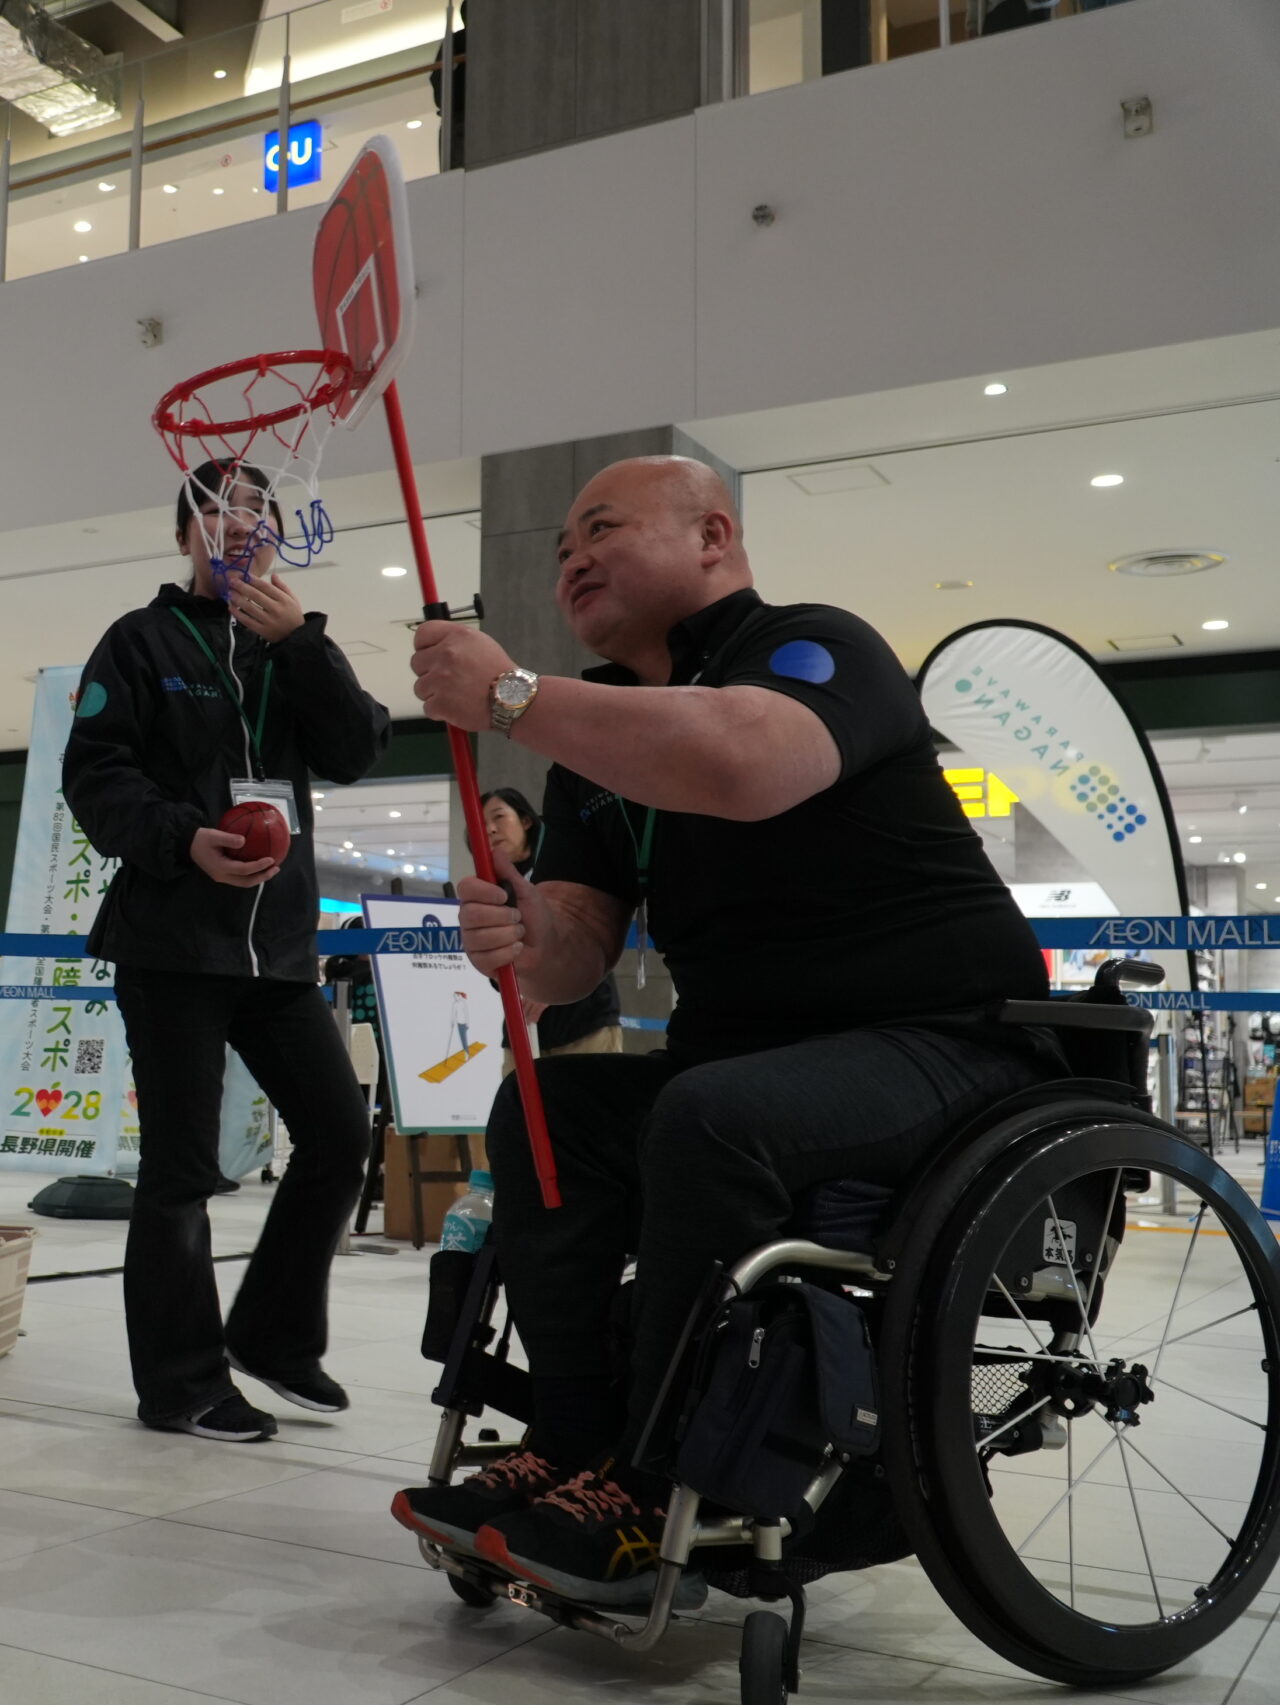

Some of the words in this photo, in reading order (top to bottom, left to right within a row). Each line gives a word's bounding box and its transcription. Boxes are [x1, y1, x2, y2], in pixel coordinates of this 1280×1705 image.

[1187, 919, 1280, 946] MALL
[27, 986, 57, 998] MALL
[1158, 992, 1211, 1009] MALL
